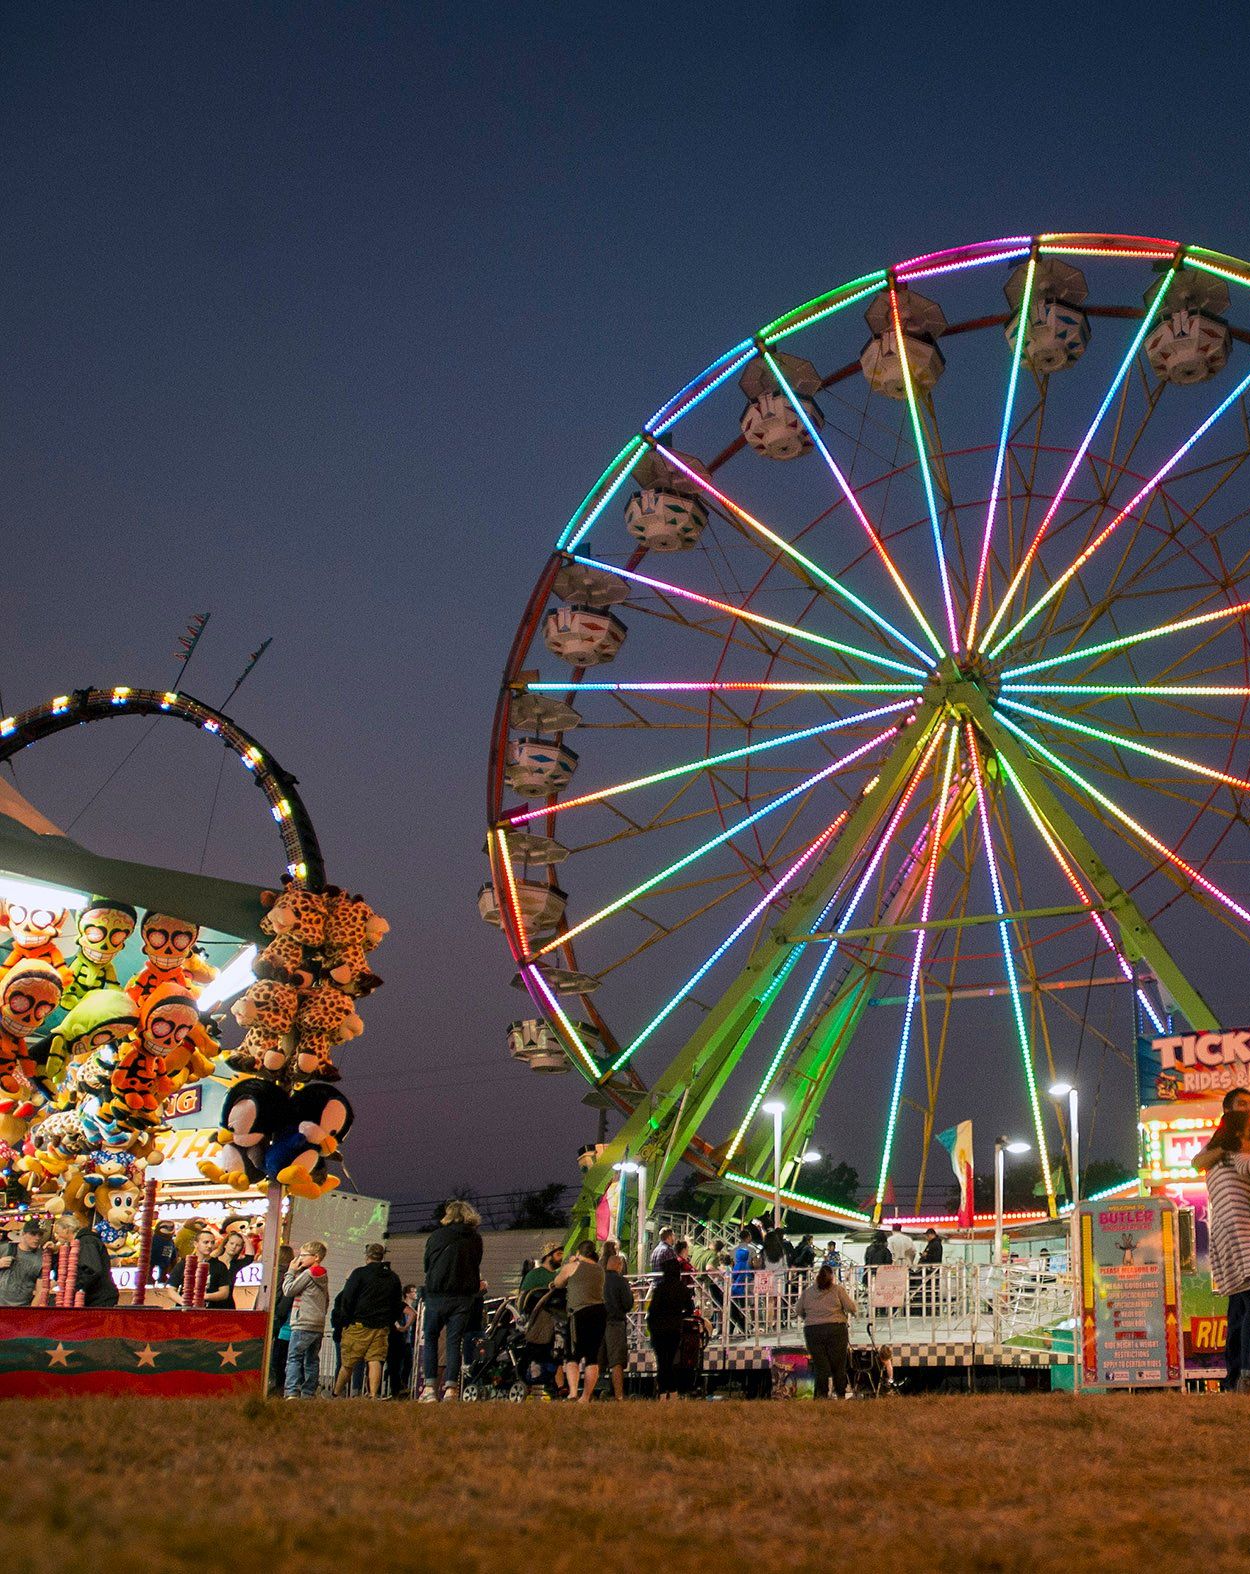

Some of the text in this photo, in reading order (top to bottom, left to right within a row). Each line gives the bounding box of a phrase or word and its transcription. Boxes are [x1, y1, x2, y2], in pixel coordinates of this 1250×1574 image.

[1183, 1071, 1231, 1091] RIDES
[1235, 1071, 1250, 1088] &
[1099, 1210, 1154, 1225] BUTLER
